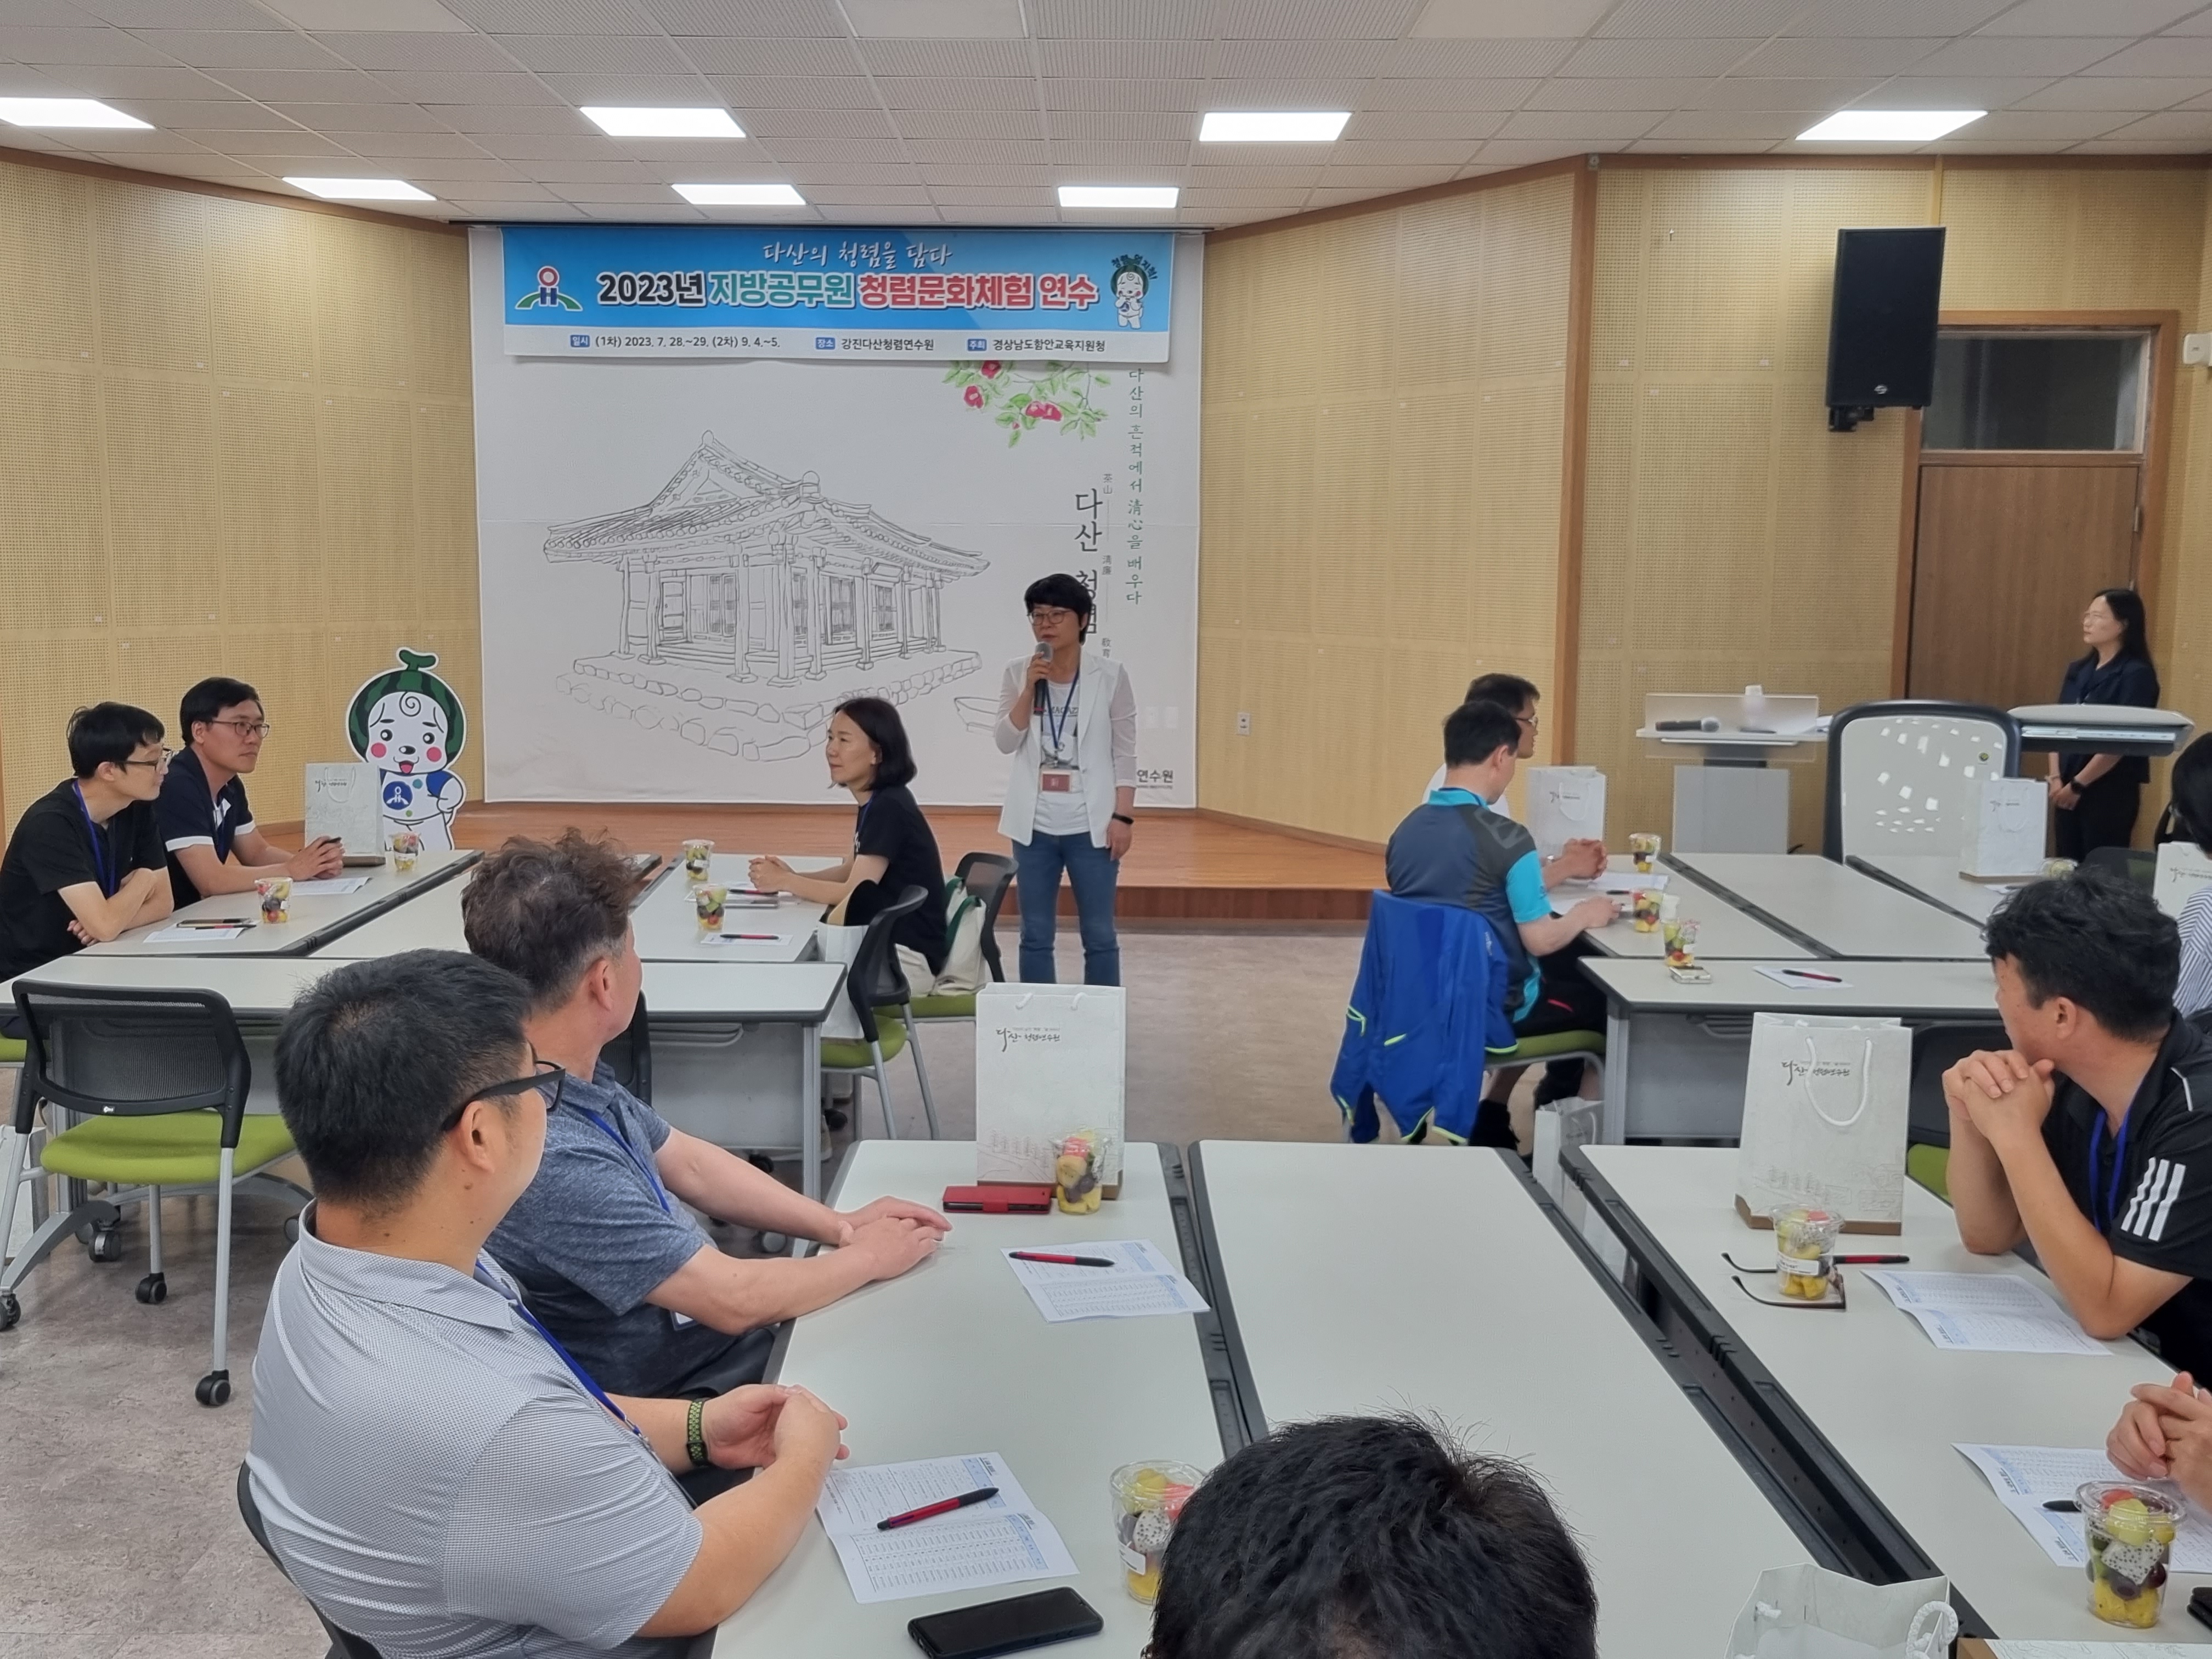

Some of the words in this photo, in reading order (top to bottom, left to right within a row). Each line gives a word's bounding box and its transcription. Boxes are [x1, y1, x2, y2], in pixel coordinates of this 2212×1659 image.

[763, 241, 827, 267] 다산의
[838, 241, 896, 270] 청렴을
[906, 242, 952, 269] 담다
[597, 272, 704, 304] 2023년
[709, 272, 853, 307] 지방공무원
[859, 274, 1031, 308] 청렴문화체험
[1039, 274, 1097, 307] 연수
[572, 336, 589, 346] 일시
[595, 336, 622, 348] (1차)
[625, 336, 654, 347] 2023.
[657, 336, 667, 348] 7.
[712, 336, 738, 348] (2차)
[741, 337, 751, 348] 9.
[753, 337, 781, 348] 4.~5.
[817, 338, 834, 349] 장소
[841, 338, 934, 351] 강진다산청렴연수원
[993, 338, 1105, 352] 경상남도함안교육지원청
[1128, 368, 1144, 419] 다산의
[1127, 424, 1144, 493] 흔적에서
[1074, 488, 1103, 552] 다산
[1125, 555, 1143, 606] 배우다
[1137, 769, 1173, 783] 연수원
